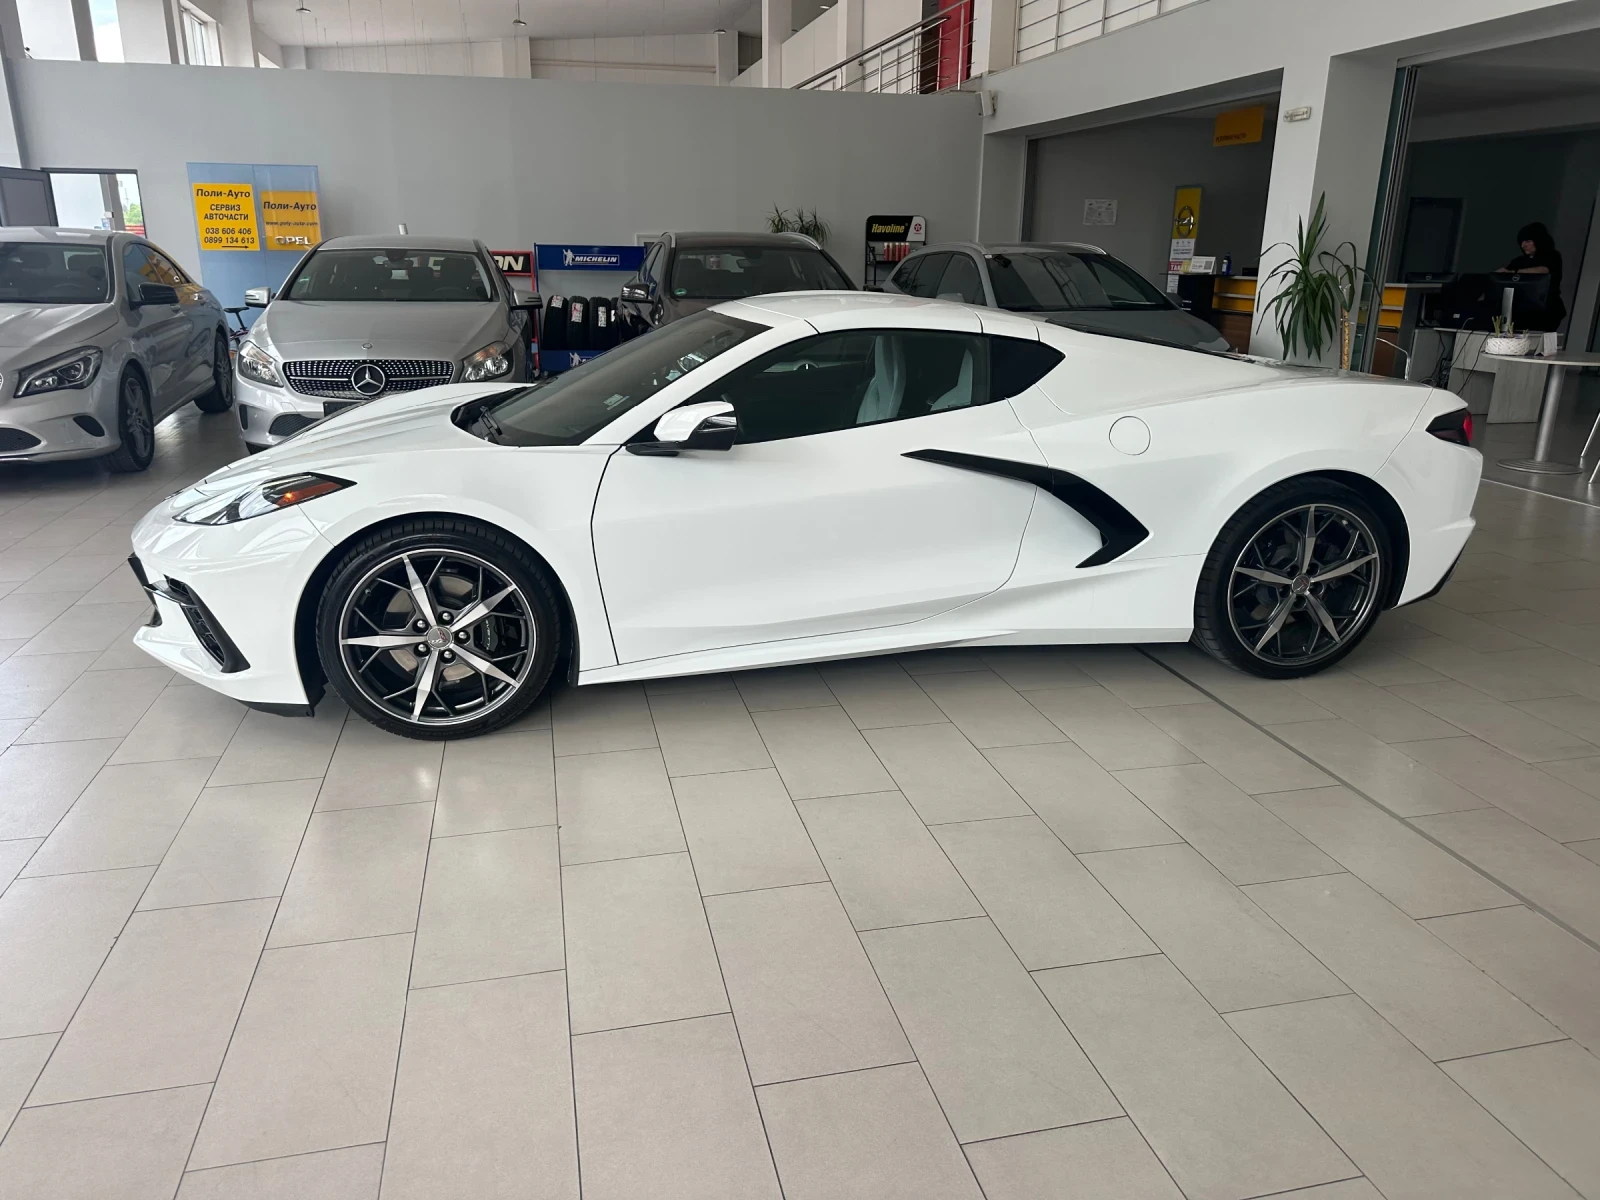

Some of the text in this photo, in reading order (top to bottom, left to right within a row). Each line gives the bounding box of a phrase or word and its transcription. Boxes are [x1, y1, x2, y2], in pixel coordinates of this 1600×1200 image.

[196, 188, 251, 199] Поли-Ауто
[210, 203, 241, 212] СЕРВИЗ
[263, 201, 317, 212] Поли-Ауто
[204, 213, 249, 221] АВТОЧАСТИ
[205, 227, 252, 235] 038 606 406
[871, 223, 905, 233] Havoline
[204, 236, 223, 244] 0899
[225, 236, 239, 244] 134
[275, 235, 312, 245] OPEL
